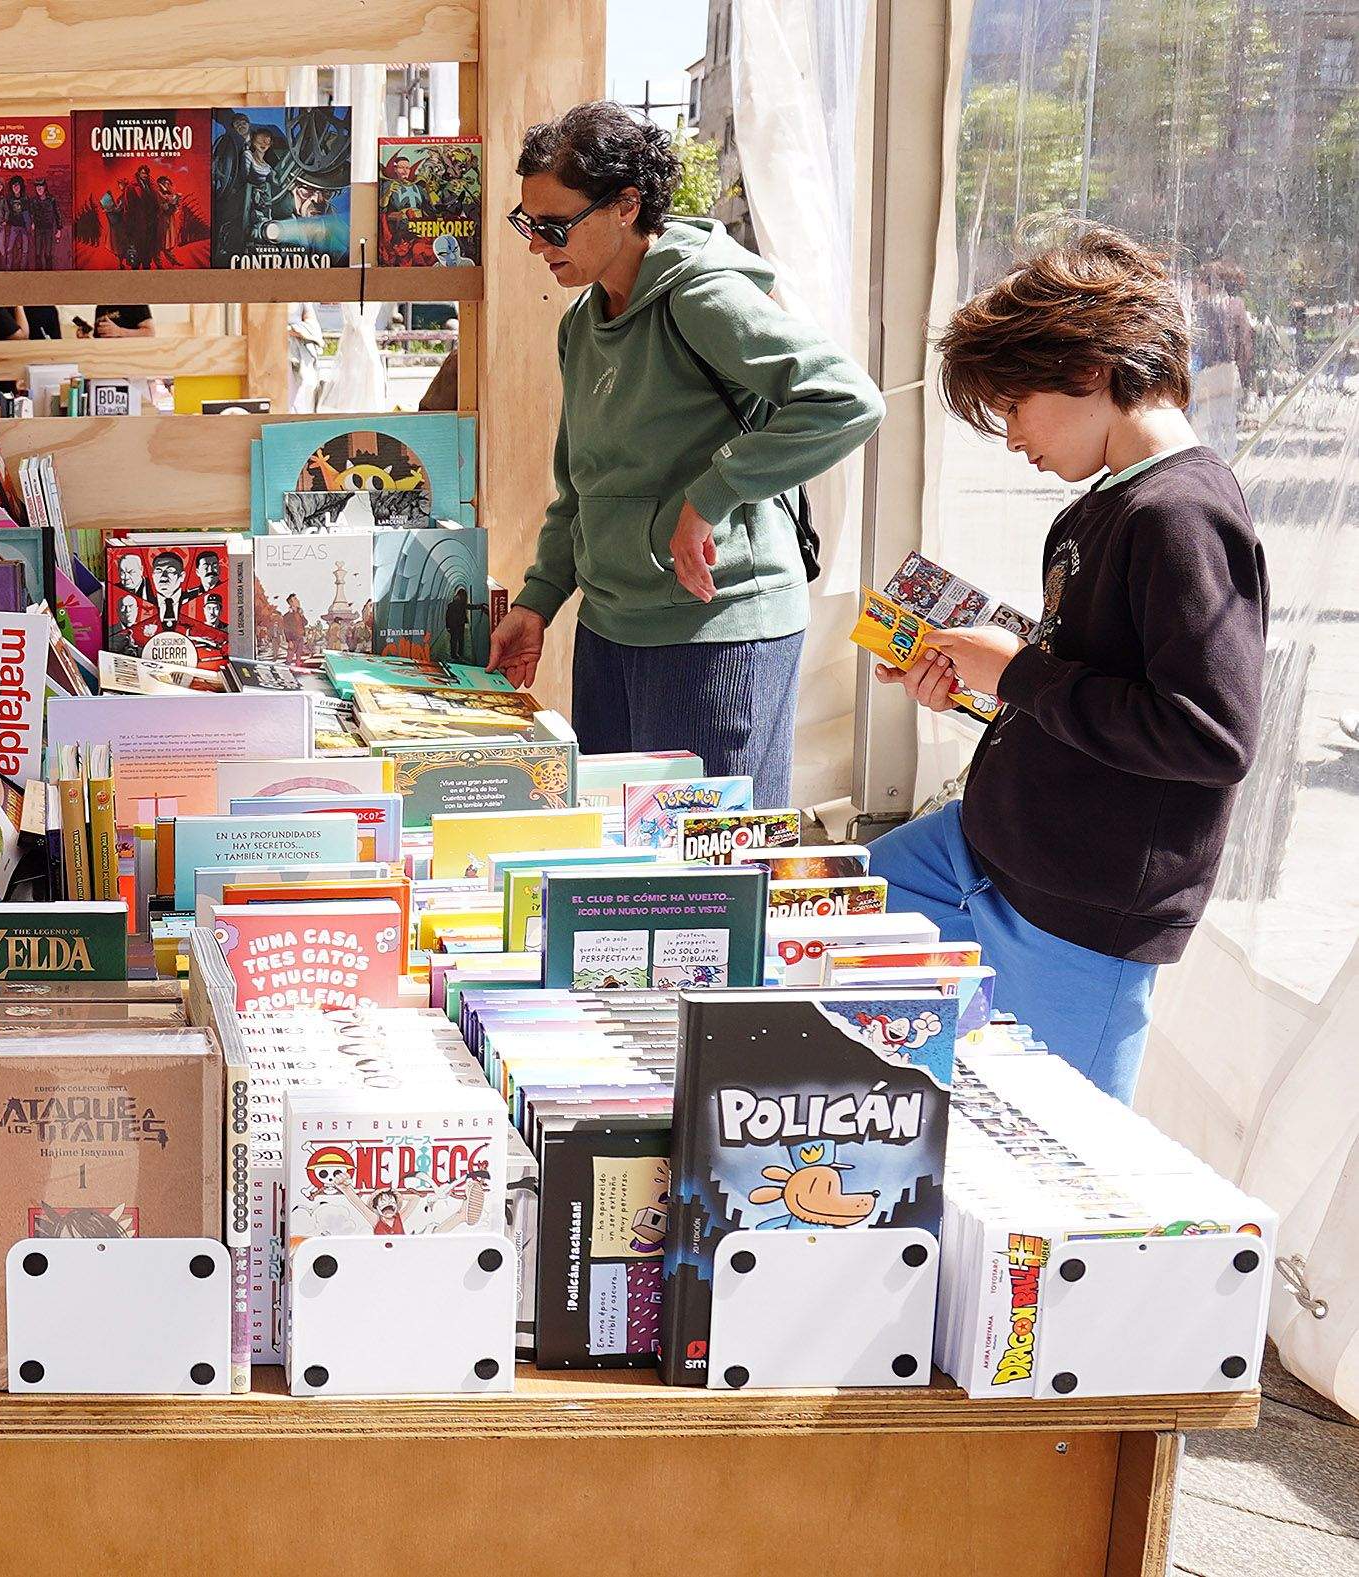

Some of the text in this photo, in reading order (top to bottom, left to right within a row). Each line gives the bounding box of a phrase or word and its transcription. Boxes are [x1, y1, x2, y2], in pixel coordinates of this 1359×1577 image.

[91, 125, 193, 152] CONTRAPASO
[3, 156, 34, 170] AÑOS
[408, 219, 475, 238] DEFENSORES
[230, 253, 332, 269] CONTRAPASO
[325, 511, 349, 527] LA
[266, 544, 329, 561] PIEZAS
[152, 647, 187, 660] GUERRA
[216, 831, 322, 840] EN LAS PROFUNDIDADES
[685, 824, 766, 861] DRAGON
[232, 841, 304, 850] HAY SECRETOS...
[215, 851, 322, 861] Y TAMBIÉN TRAICIONES.
[587, 895, 613, 903] CLUB
[633, 893, 667, 902] CÓMIC
[687, 893, 735, 901] VUELTO...
[578, 908, 601, 916] ¡CON
[618, 907, 648, 915] NUEVO
[698, 906, 726, 914] VISTA!
[33, 928, 67, 936] LEGEND
[249, 928, 364, 955] ¡UNA CASA,
[242, 949, 370, 973] TRES GATOS
[251, 967, 359, 992] Y MUCHOS
[35, 1085, 128, 1093] EDICIÓN COLECCIONISTA
[142, 1107, 156, 1121] A
[232, 1080, 248, 1133] JUST
[720, 1081, 923, 1145] POLICÁN
[302, 1117, 494, 1131] EAST BLUE SAGA
[7, 1119, 169, 1150] LOS TITANES
[40, 1147, 124, 1159] Hajime Isayama
[77, 1164, 87, 1189] 1
[232, 1144, 249, 1233] FRIENDS
[609, 1176, 617, 1209] extraño
[597, 1172, 606, 1231] ha aparecido
[620, 1214, 629, 1232] muy
[609, 1230, 615, 1241] un
[1041, 1238, 1051, 1268] SUPER
[252, 1181, 263, 1353] EAST BLUE SAGA
[599, 1292, 607, 1316] época
[607, 1314, 615, 1347] terrible
[991, 1266, 1040, 1385] DRAGON BALL
[597, 1338, 605, 1348] En
[685, 1358, 707, 1369] sm
